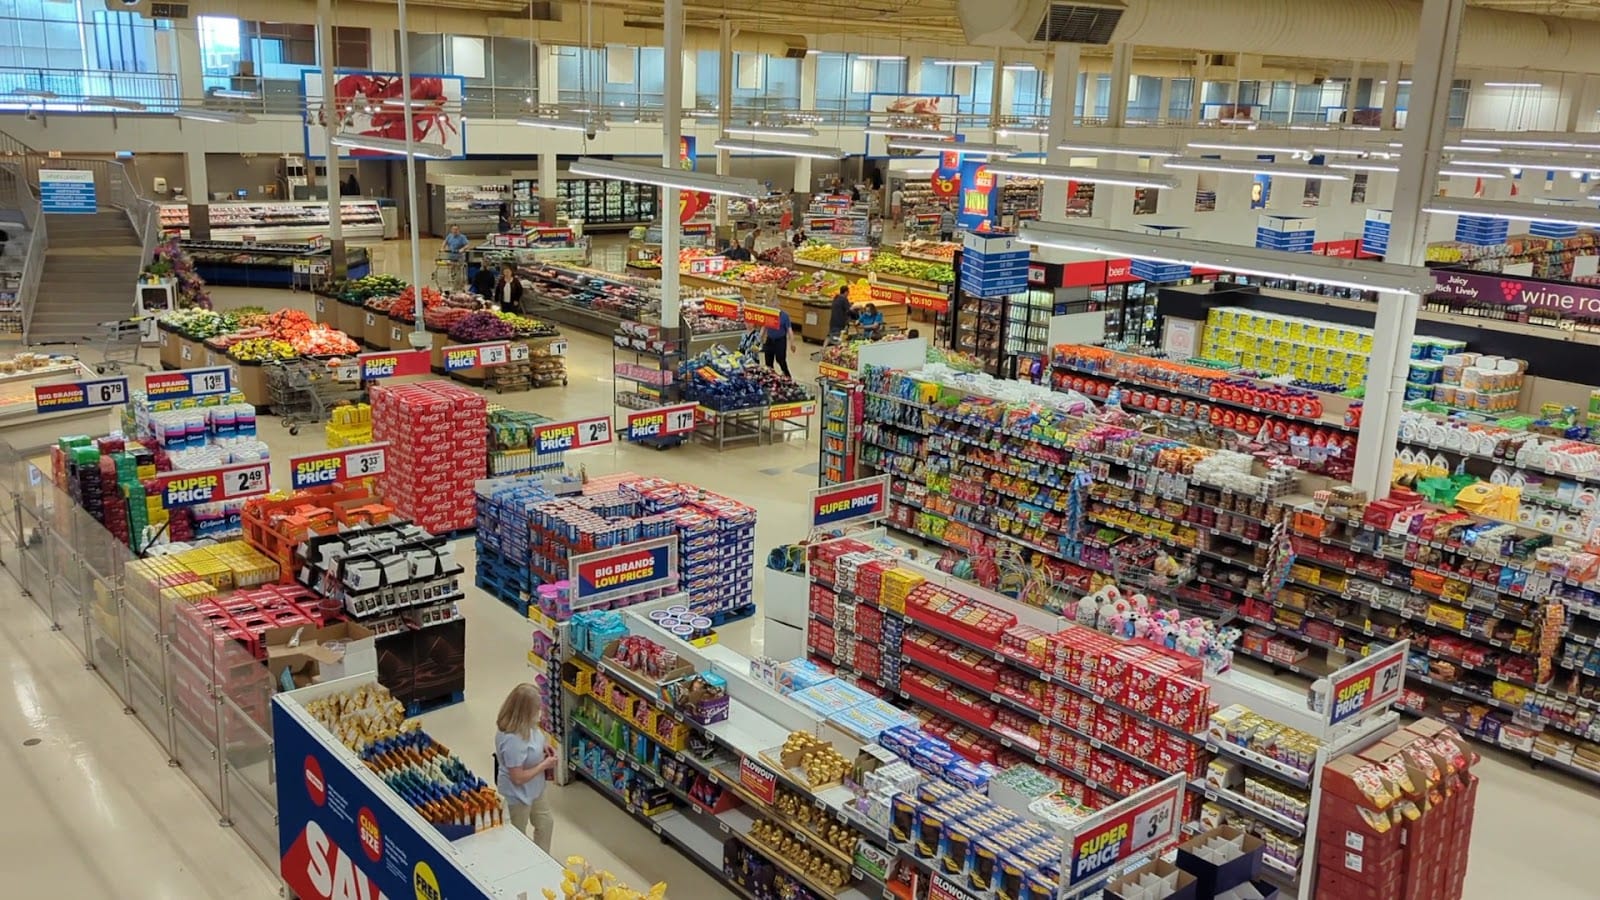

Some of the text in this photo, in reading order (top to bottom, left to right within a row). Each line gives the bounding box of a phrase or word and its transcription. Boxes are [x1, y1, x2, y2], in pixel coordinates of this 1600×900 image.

[1108, 267, 1124, 276] beer
[1448, 276, 1469, 287] Juicy
[1435, 284, 1479, 298] Rich Lively
[1522, 287, 1574, 310] wine
[448, 349, 477, 359] SUPER
[365, 365, 394, 376] PRICE
[366, 357, 398, 368] SUPER
[448, 358, 475, 367] PRICE
[161, 380, 189, 388] BRANDS
[53, 390, 83, 399] BRANDS
[632, 416, 664, 428] SUPER
[540, 426, 575, 440] SUPER
[632, 424, 660, 438] PRICE
[540, 436, 572, 450] PRICE
[297, 458, 342, 474] SUPER
[168, 475, 217, 492] SUPER
[297, 469, 336, 485] PRICE
[168, 488, 212, 504] PRICE
[819, 494, 878, 515] SUPER PRICE
[595, 557, 655, 578] BIG BRANDS
[595, 567, 654, 589] LOW PRICES
[1338, 677, 1370, 703] SUPER
[1335, 693, 1365, 719] PRICE
[743, 758, 774, 782] BLOWOUT
[360, 815, 379, 840] CLUB
[360, 827, 379, 854] SIZE
[1079, 823, 1128, 859] SUPER
[1077, 842, 1120, 877] PRICE
[416, 872, 438, 900] FREE
